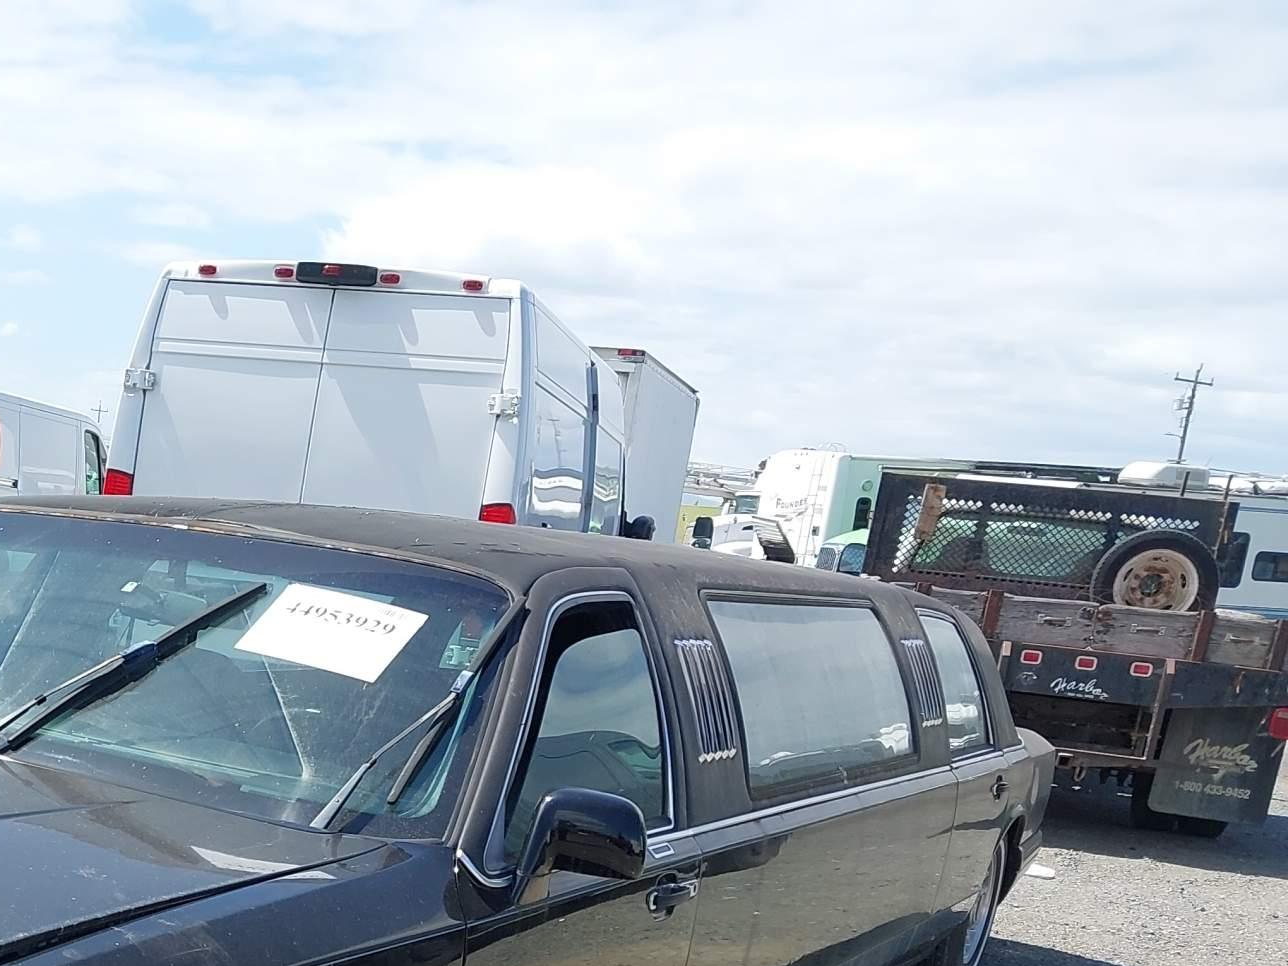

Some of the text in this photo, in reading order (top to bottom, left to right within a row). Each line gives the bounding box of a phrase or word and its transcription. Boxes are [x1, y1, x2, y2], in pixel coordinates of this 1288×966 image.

[286, 602, 397, 635] 44953929
[1050, 677, 1109, 700] Harbor
[1183, 738, 1258, 772] Harbor
[1175, 781, 1251, 800] 1-800 433-9452
